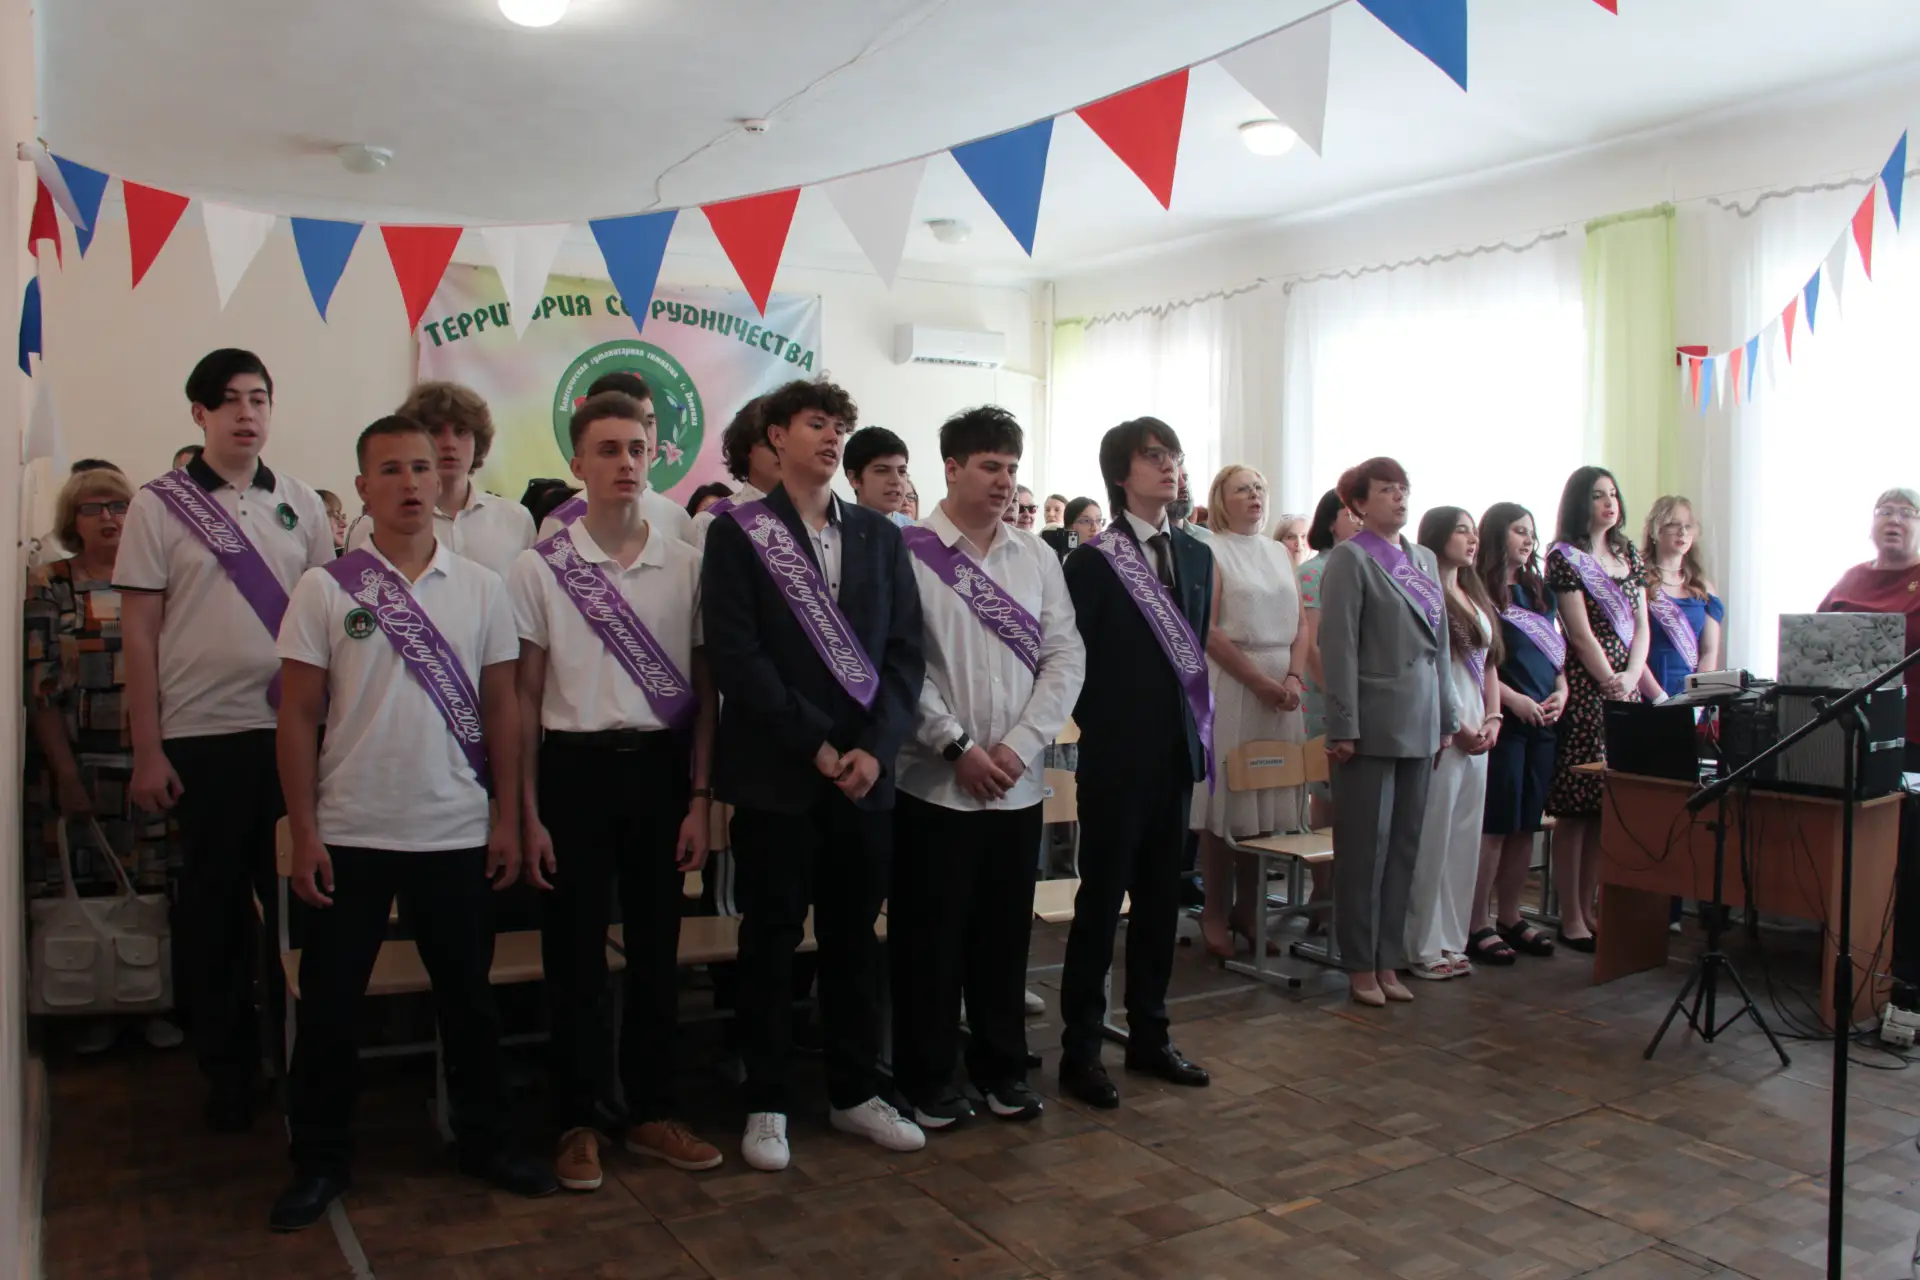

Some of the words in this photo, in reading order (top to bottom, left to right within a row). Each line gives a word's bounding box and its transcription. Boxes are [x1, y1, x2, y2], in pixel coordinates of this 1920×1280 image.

[424, 294, 592, 347] ТЕРРИРИЯ
[647, 352, 679, 379] гимназия
[203, 520, 249, 554] 2026
